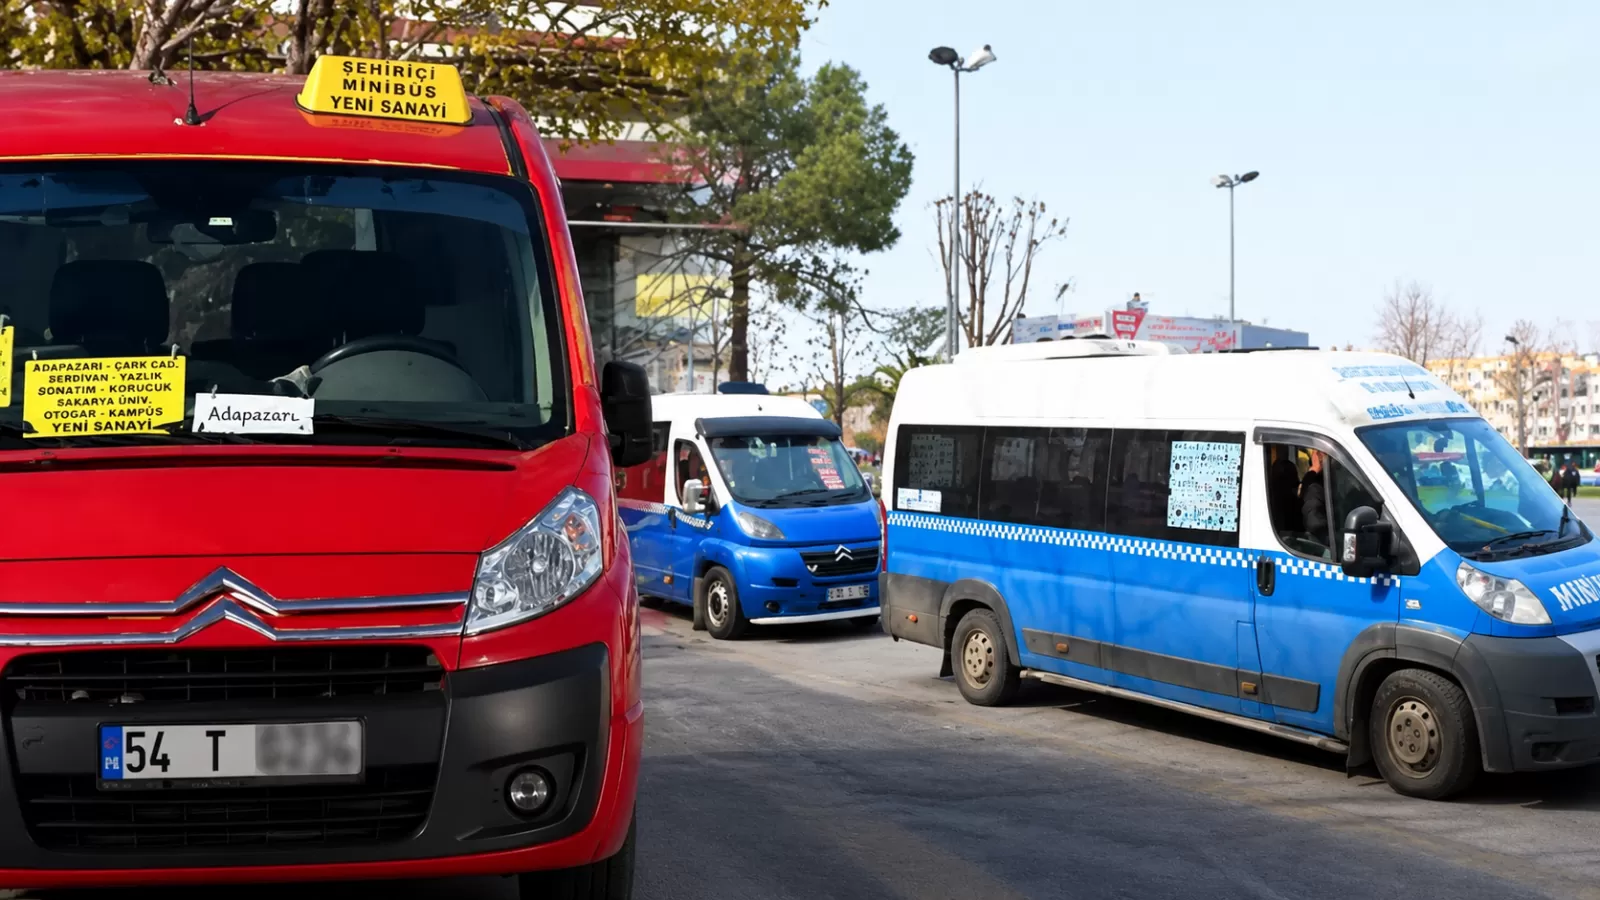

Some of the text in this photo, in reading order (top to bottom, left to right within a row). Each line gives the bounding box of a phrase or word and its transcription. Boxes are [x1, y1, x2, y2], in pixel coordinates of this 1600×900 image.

[342, 61, 435, 82] ŞEHİRİÇİ
[343, 77, 436, 98] MİNİBÜS
[330, 95, 446, 118] YENİ SANAYİ
[33, 362, 102, 372] ADAPAZARI
[114, 361, 147, 372] ÇARK
[151, 360, 179, 369] CAD.
[49, 373, 108, 383] SERDİVAN
[120, 372, 162, 382] YAZLIK
[38, 386, 96, 396] SONATIM
[109, 383, 172, 393] KORUCUK
[57, 394, 152, 407] SAKARYA ÜNİV.
[44, 410, 96, 419] OTOGAR
[109, 405, 163, 417] KAMPÜS
[208, 405, 300, 427] Adapazarı
[52, 418, 152, 433] YENİ SANAYİ
[126, 731, 170, 773] 54
[206, 730, 226, 771] T
